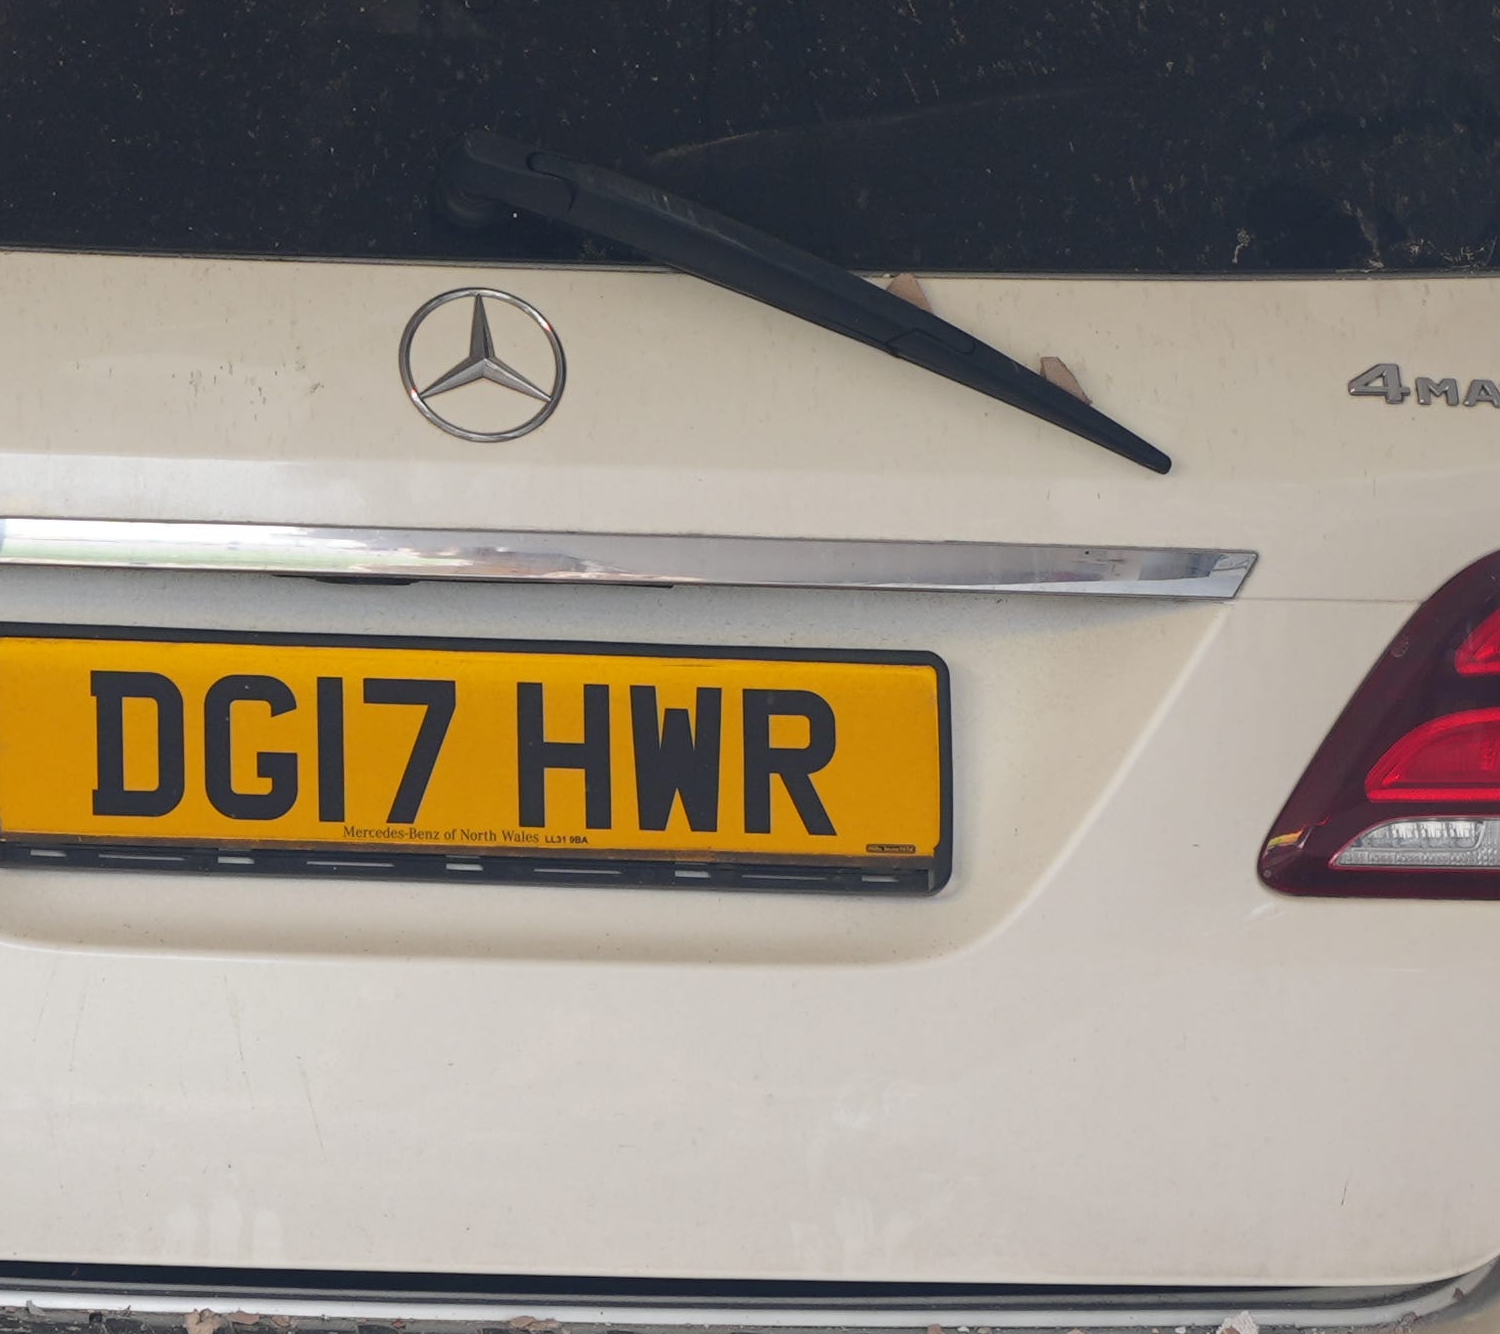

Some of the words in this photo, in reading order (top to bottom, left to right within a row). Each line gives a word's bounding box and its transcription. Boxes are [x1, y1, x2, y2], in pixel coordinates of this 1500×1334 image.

[90, 670, 457, 824] DG17
[517, 681, 838, 836] HWR
[343, 825, 440, 841] Mercedes-Benz
[443, 827, 459, 841] of
[460, 828, 498, 843] North
[501, 830, 540, 844] Wales
